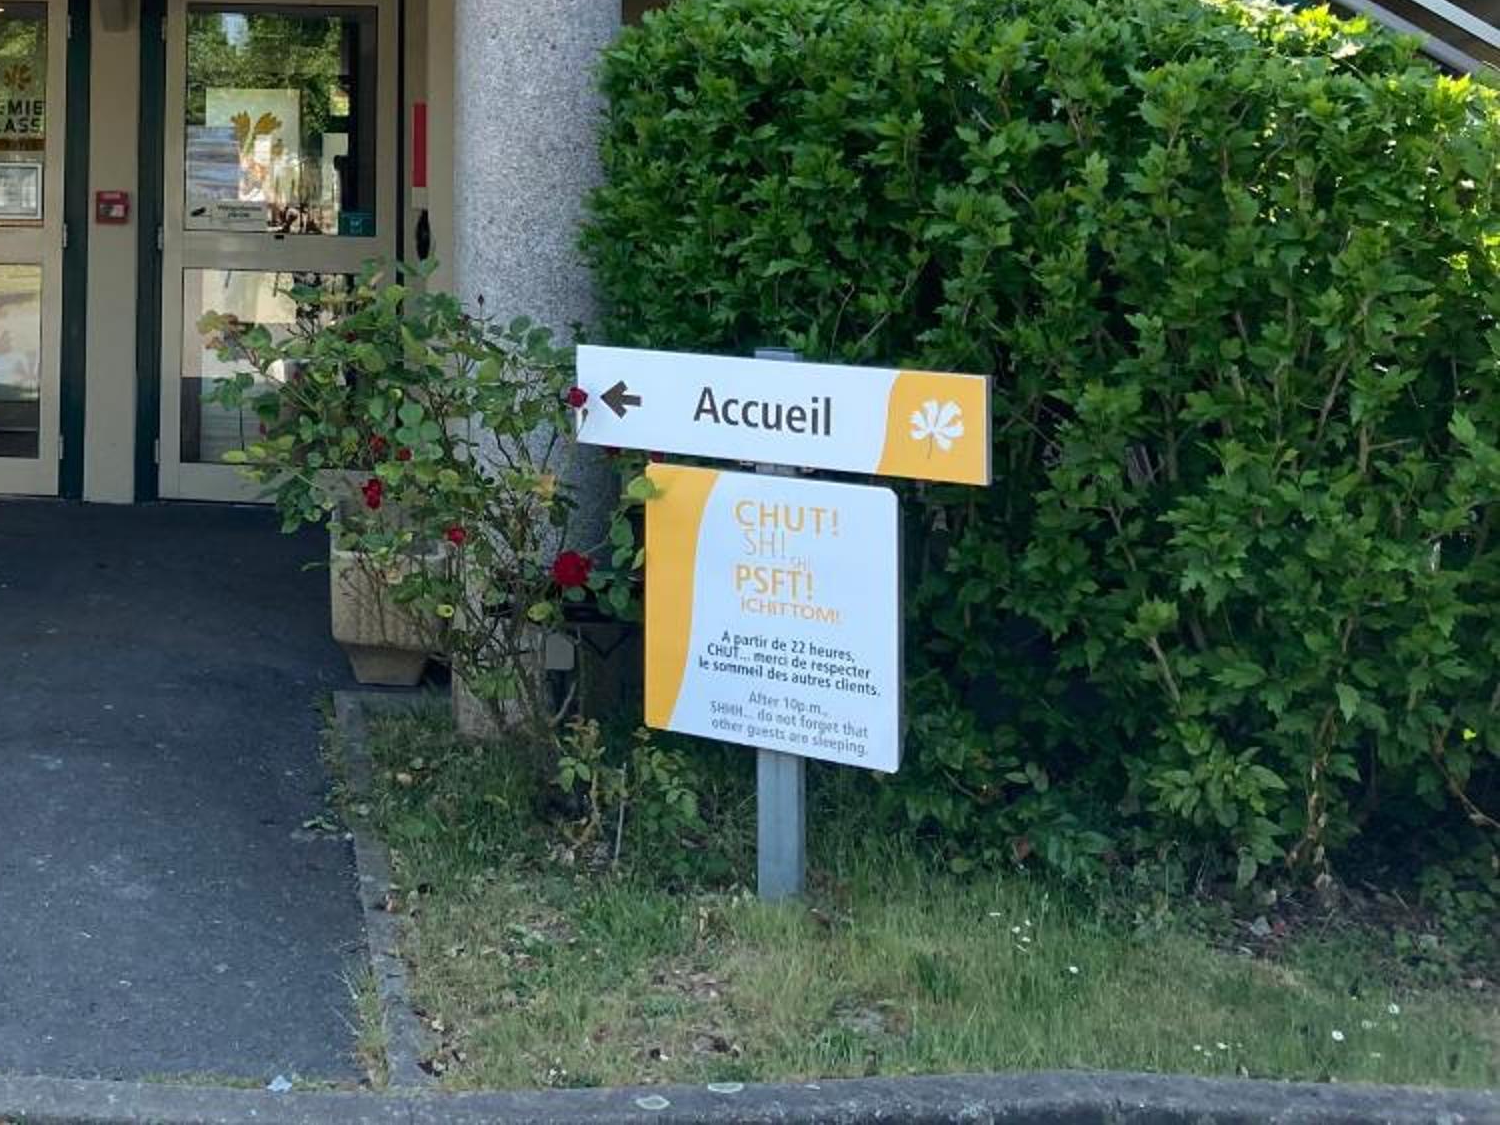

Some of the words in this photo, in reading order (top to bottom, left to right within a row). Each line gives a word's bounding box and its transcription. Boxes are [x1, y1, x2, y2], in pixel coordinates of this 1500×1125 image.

[693, 386, 833, 437] Accueil
[734, 499, 839, 538] CHUT!
[735, 563, 813, 601] PSFT!
[734, 633, 768, 648] partir
[771, 637, 787, 651] de
[791, 640, 805, 655] 22
[809, 642, 855, 663] heures,
[753, 651, 788, 667] merci
[791, 656, 807, 671] de
[811, 661, 870, 681] respecter
[699, 656, 709, 671] le
[713, 660, 763, 679] sommeil
[767, 668, 788, 683] des
[791, 672, 831, 689] autres
[835, 678, 881, 698] clients.
[749, 690, 779, 707] After
[711, 718, 743, 733] other
[747, 725, 785, 742] guests
[788, 731, 808, 744] are
[812, 733, 869, 756] sleeping.
[757, 708, 773, 723] do
[775, 713, 797, 728] not
[800, 714, 838, 736] forget
[843, 723, 869, 740] that
